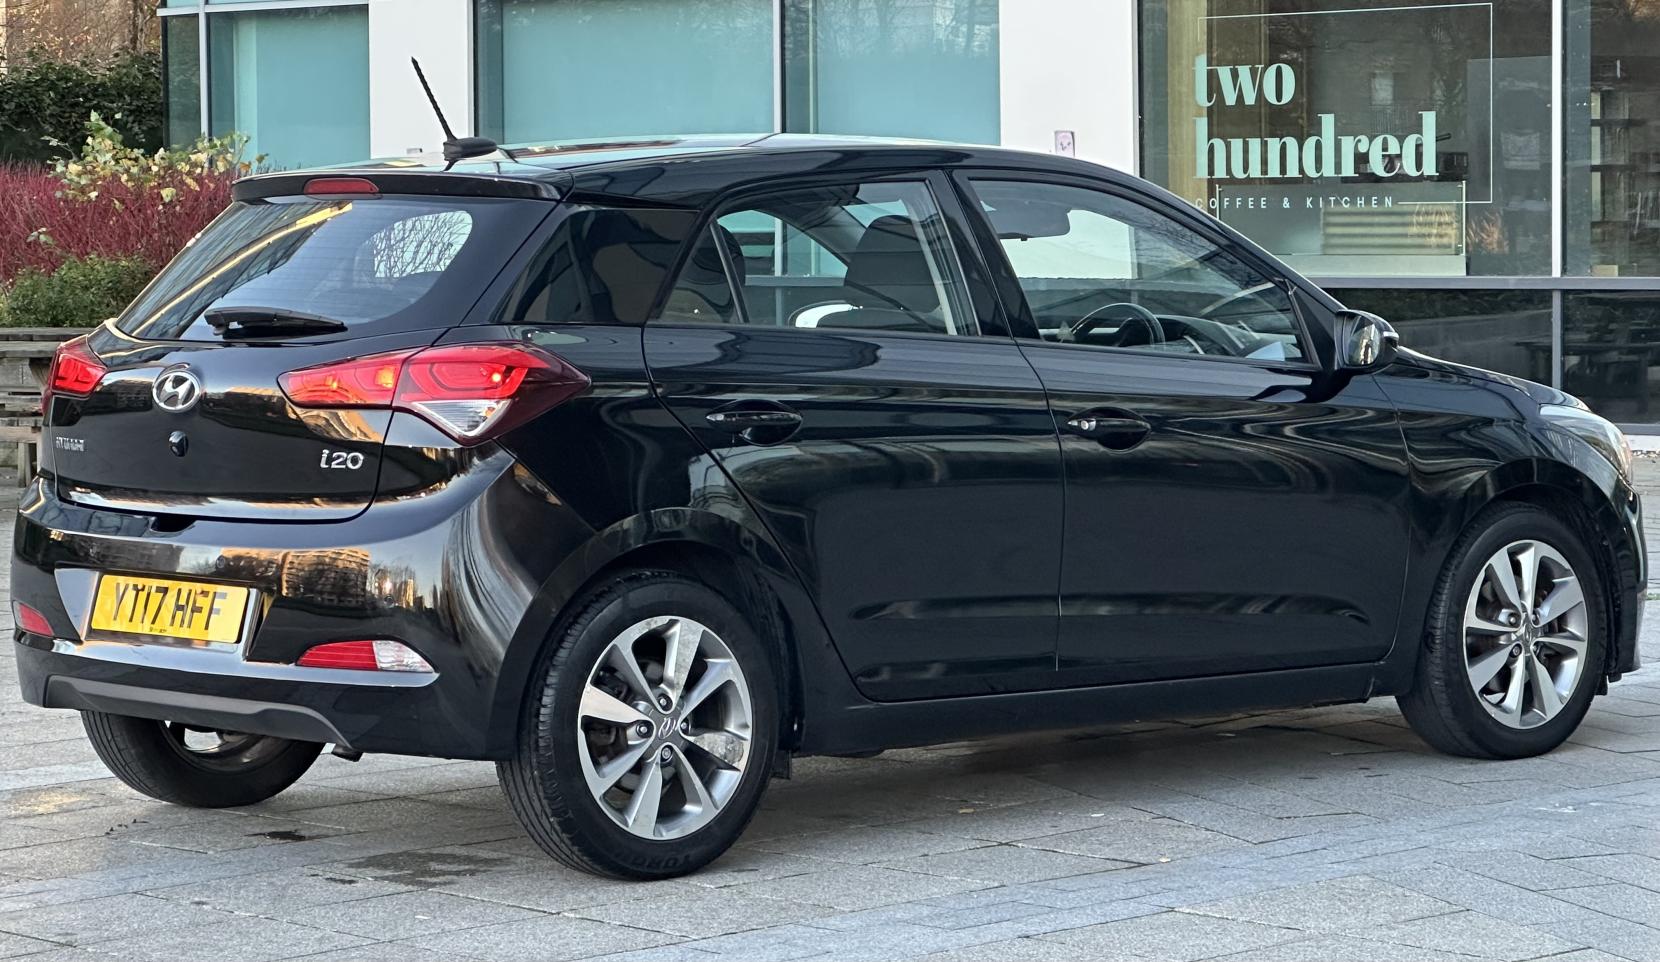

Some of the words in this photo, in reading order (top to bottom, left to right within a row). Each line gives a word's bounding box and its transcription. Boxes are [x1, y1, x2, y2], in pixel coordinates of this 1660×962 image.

[1192, 53, 1296, 107] two
[1192, 111, 1440, 179] hundred
[1195, 197, 1267, 209] COFFEE
[1282, 197, 1290, 209] &
[1306, 196, 1393, 209] KITCHEN
[320, 449, 364, 470] i20
[112, 582, 169, 625] YT17
[169, 587, 228, 631] HFF
